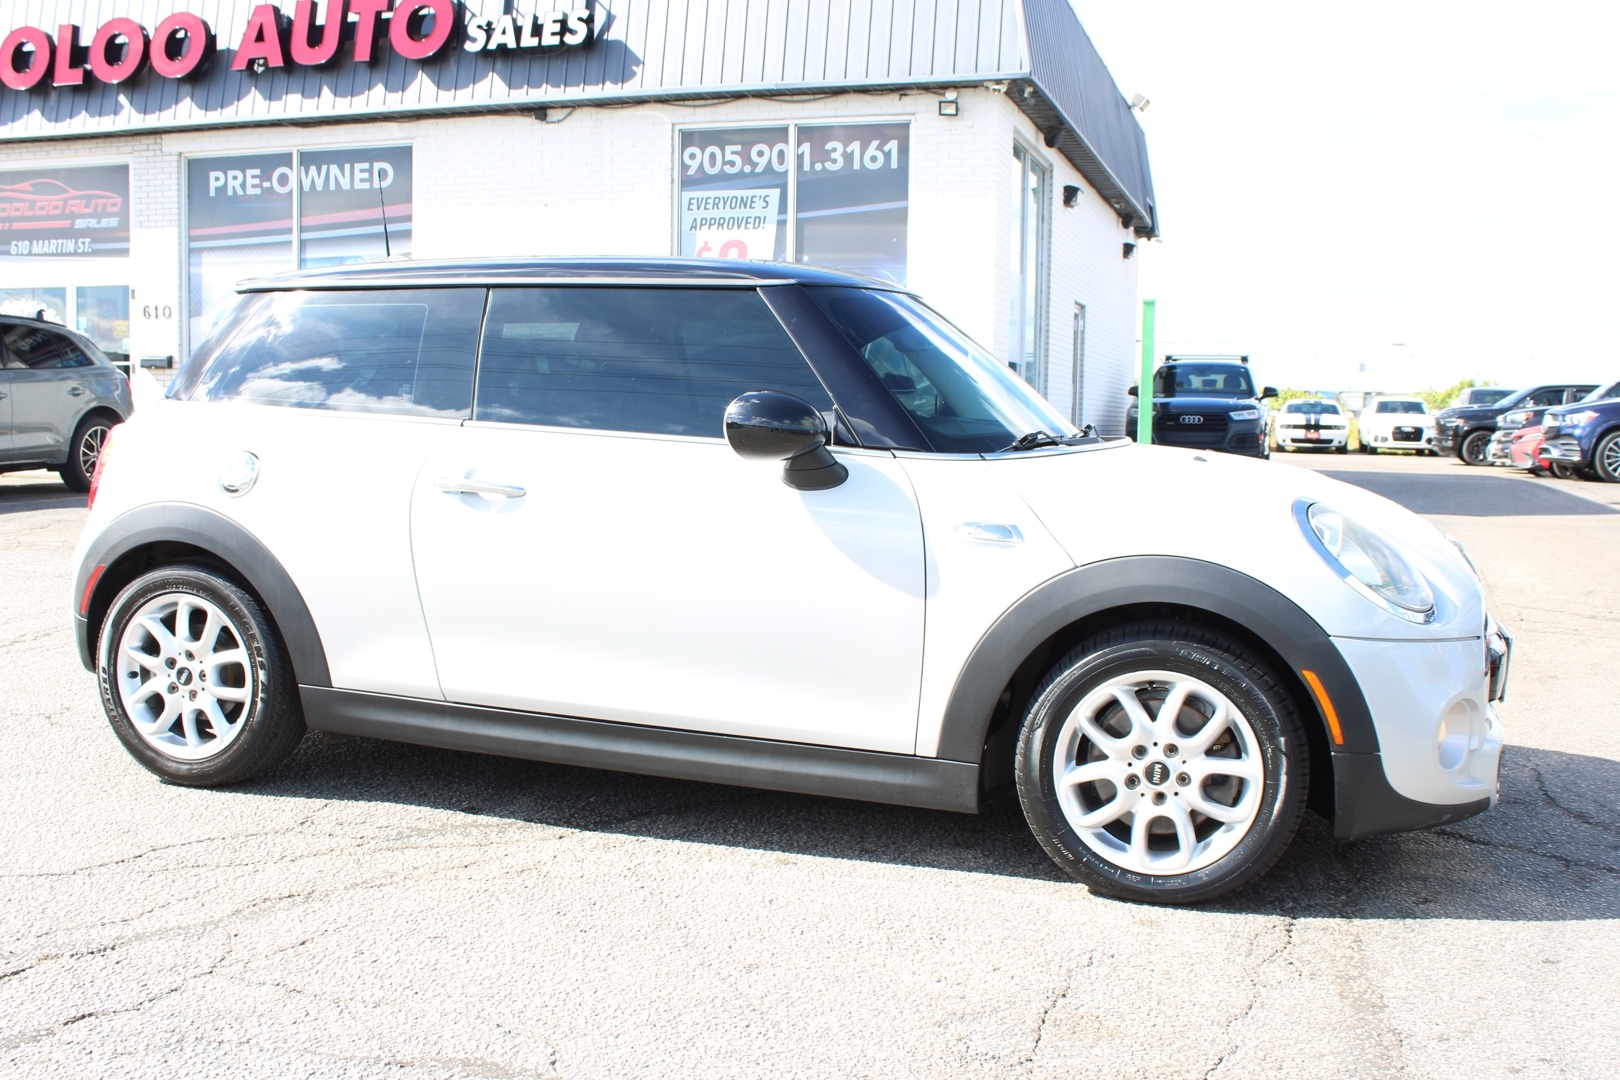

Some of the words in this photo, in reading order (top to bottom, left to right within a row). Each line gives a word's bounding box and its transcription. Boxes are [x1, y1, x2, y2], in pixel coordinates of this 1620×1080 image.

[230, 0, 454, 71] AUTO
[463, 8, 591, 53] SALES
[682, 139, 899, 176] 905.901.3161
[209, 161, 395, 197] PRE-OWNED
[65, 197, 122, 215] AUTO
[687, 194, 770, 212] EVERYONE'S
[74, 217, 120, 229] SALES
[689, 215, 767, 232] APPROVED!
[10, 240, 30, 255] 610
[31, 238, 76, 255] MARTIN
[77, 238, 92, 253] ST.
[143, 305, 172, 320] 610
[1152, 763, 1162, 784] MINI
